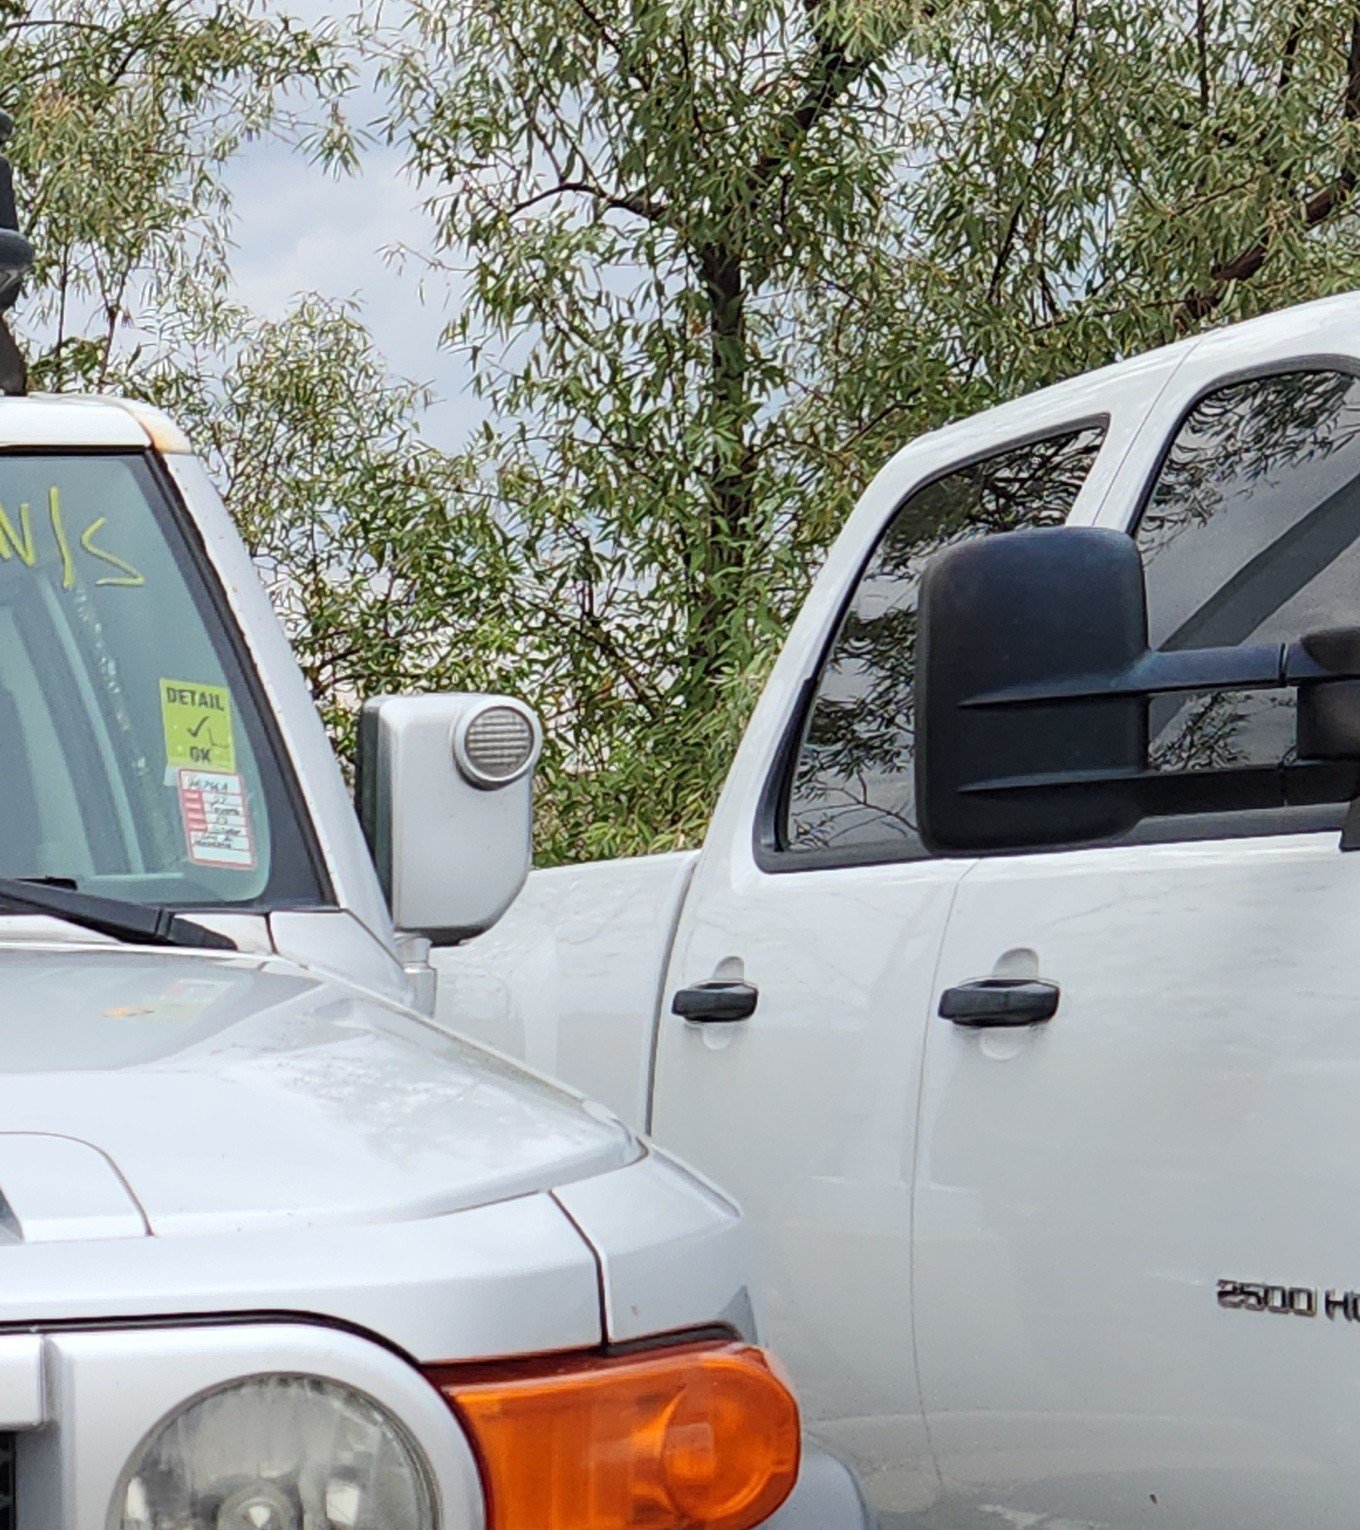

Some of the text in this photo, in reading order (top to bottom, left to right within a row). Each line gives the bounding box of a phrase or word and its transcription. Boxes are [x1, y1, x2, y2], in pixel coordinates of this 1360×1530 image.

[166, 685, 226, 711] DETAIL
[189, 746, 211, 763] OK
[1217, 1278, 1317, 1318] 2500
